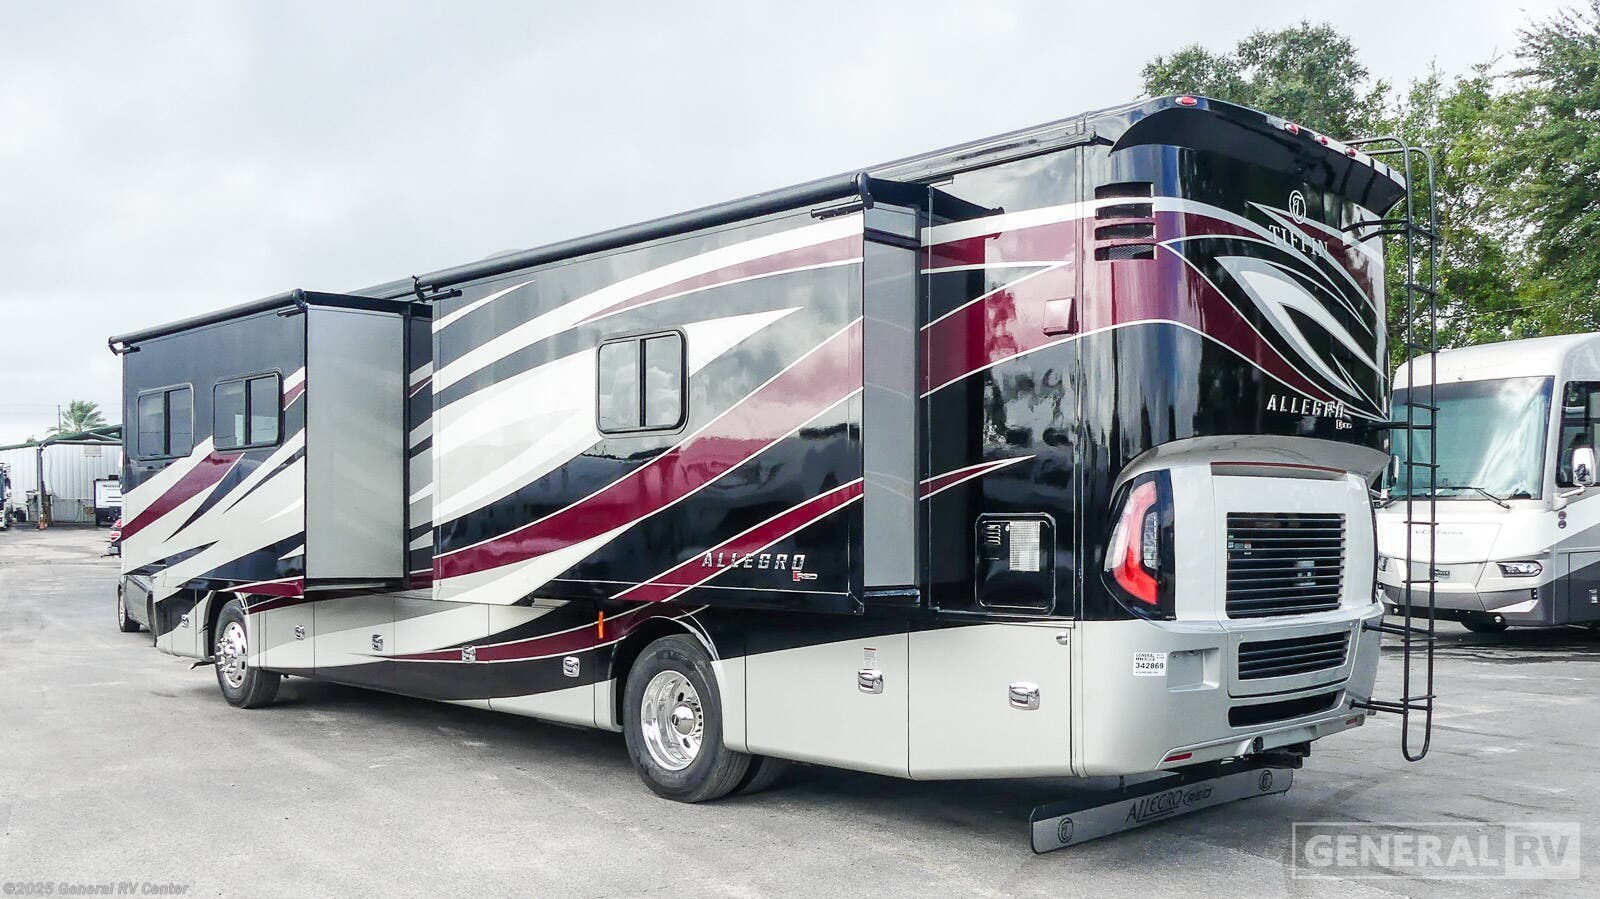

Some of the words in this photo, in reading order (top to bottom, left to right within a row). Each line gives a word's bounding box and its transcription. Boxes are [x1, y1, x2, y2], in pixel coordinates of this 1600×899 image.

[1268, 224, 1328, 257] TIFFIN
[1266, 394, 1345, 419] ALLEGRO
[701, 552, 806, 570] ALLEGRO
[1126, 789, 1183, 823] ALLEGRO
